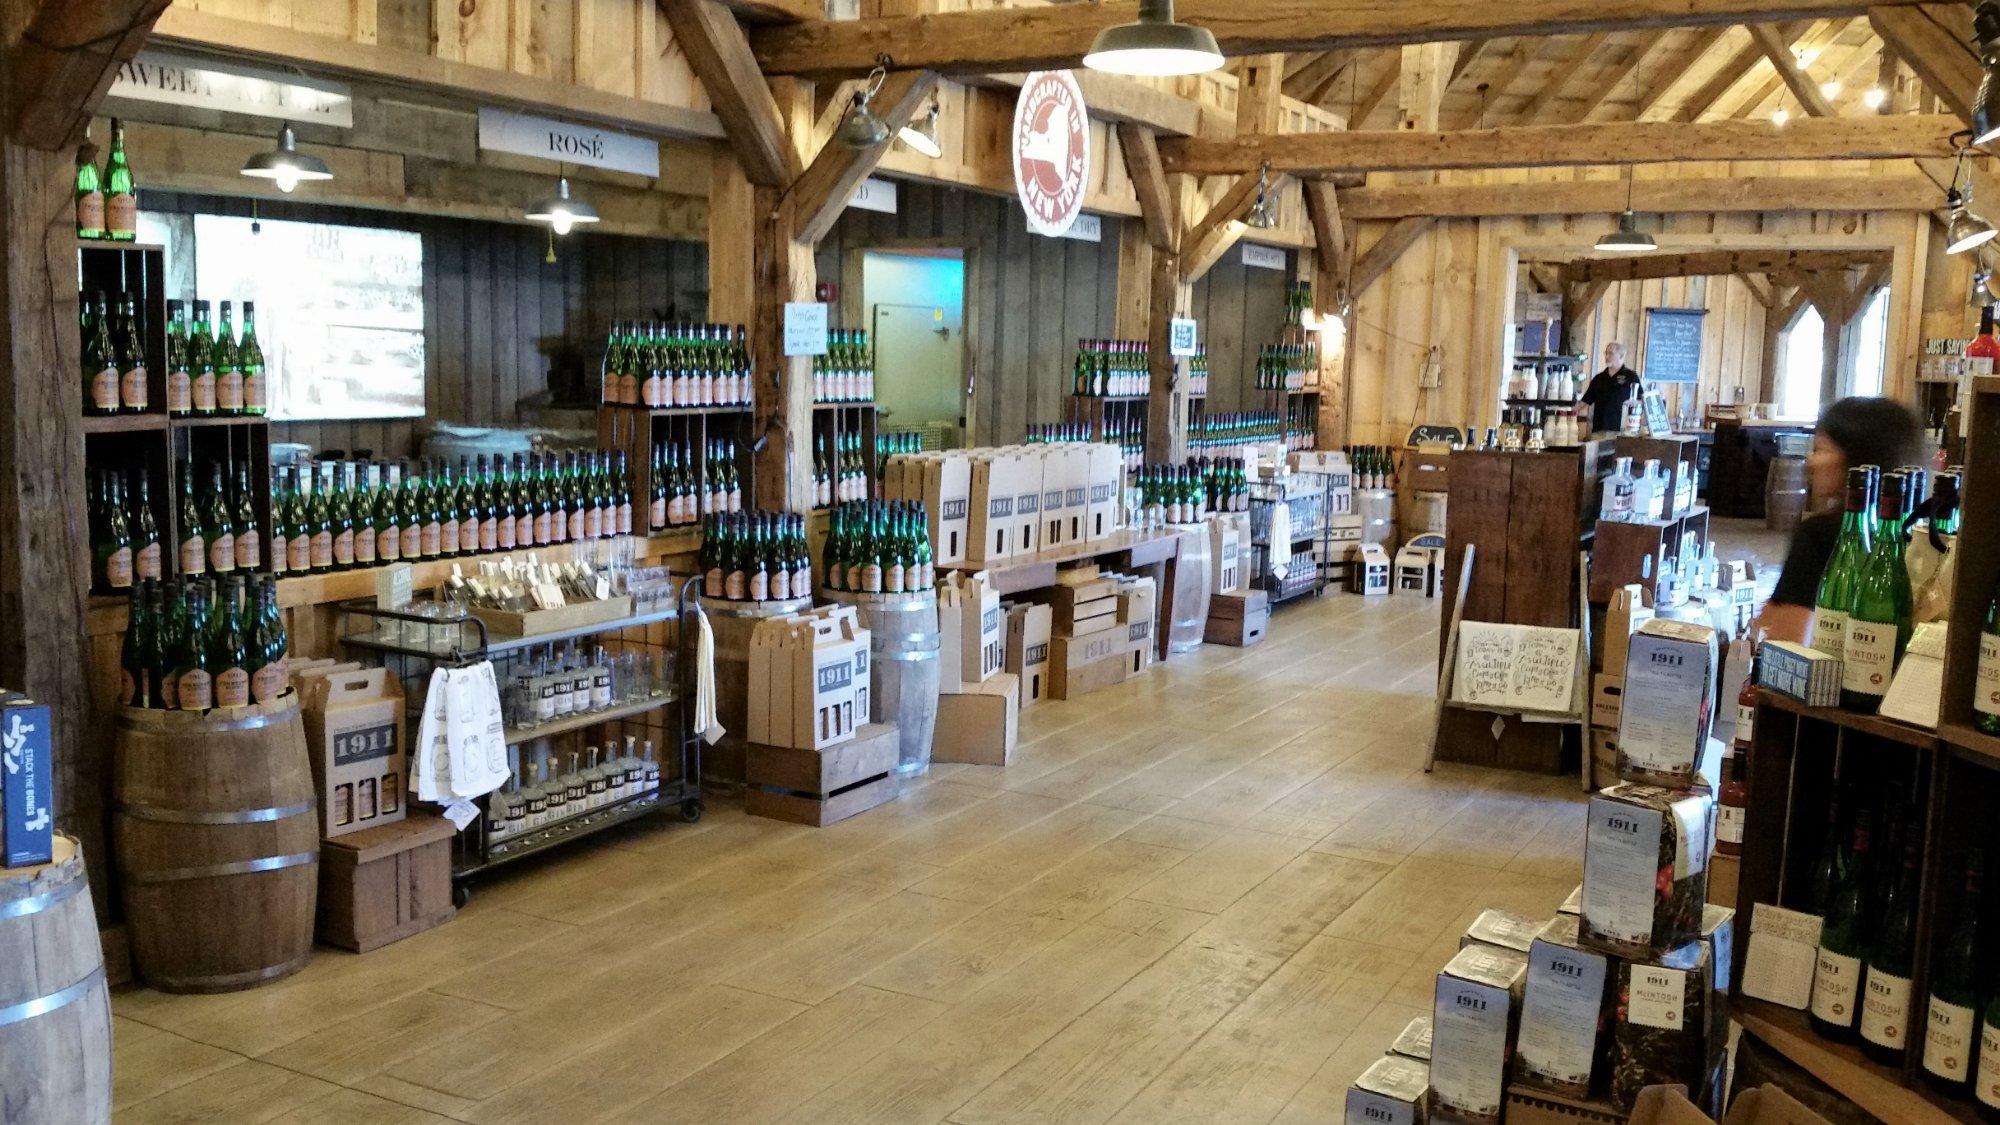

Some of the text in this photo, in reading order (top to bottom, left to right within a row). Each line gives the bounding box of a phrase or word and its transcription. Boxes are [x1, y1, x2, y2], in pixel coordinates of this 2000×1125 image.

[549, 131, 604, 160] ROSÉ
[1027, 156, 1083, 220] NEW YORK
[1926, 338, 1944, 355] JUST
[1819, 620, 1841, 630] 1911
[1852, 632, 1876, 643] 1911
[1026, 646, 1048, 664] 1911
[1086, 640, 1112, 659] 1911
[1651, 653, 1683, 666] 1911
[820, 665, 850, 687] 1911
[336, 728, 394, 758] 1911
[24, 748, 35, 817] STACK THE BONES
[1608, 817, 1638, 833] 1911
[1551, 961, 1583, 977] 1911
[1820, 959, 1839, 973] 1911
[1647, 976, 1669, 985] 1911
[1870, 980, 1891, 995] 1911
[1456, 995, 1487, 1010] 1911
[1366, 1107, 1393, 1122] 1911
